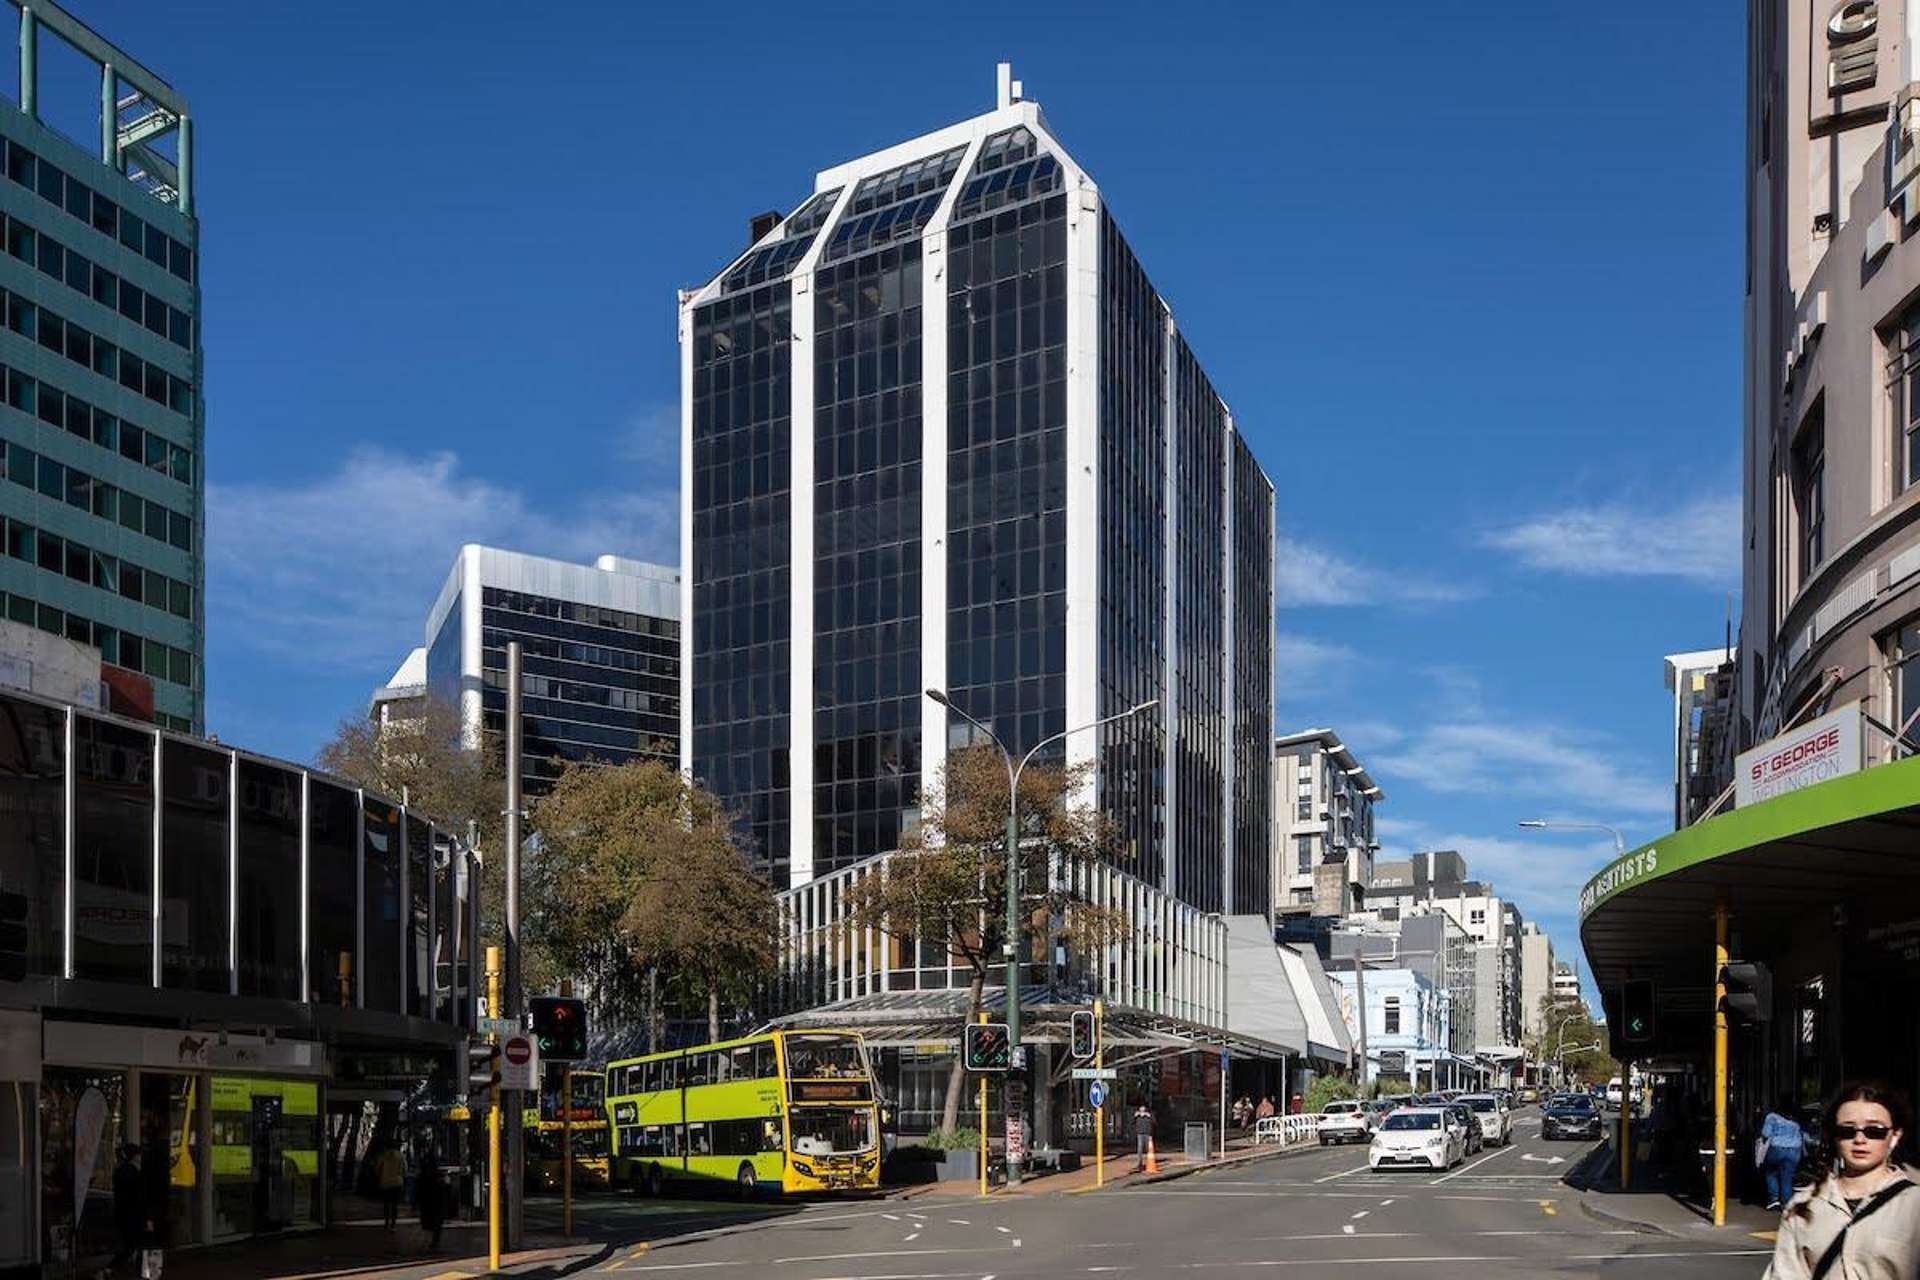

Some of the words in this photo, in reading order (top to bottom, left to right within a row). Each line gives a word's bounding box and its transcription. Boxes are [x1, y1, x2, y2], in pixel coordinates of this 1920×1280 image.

[1751, 760, 1769, 781] ST
[1771, 728, 1840, 772] GEORGE
[1763, 753, 1827, 784] ACCOMMODATION
[1751, 757, 1840, 801] WELLINGTON
